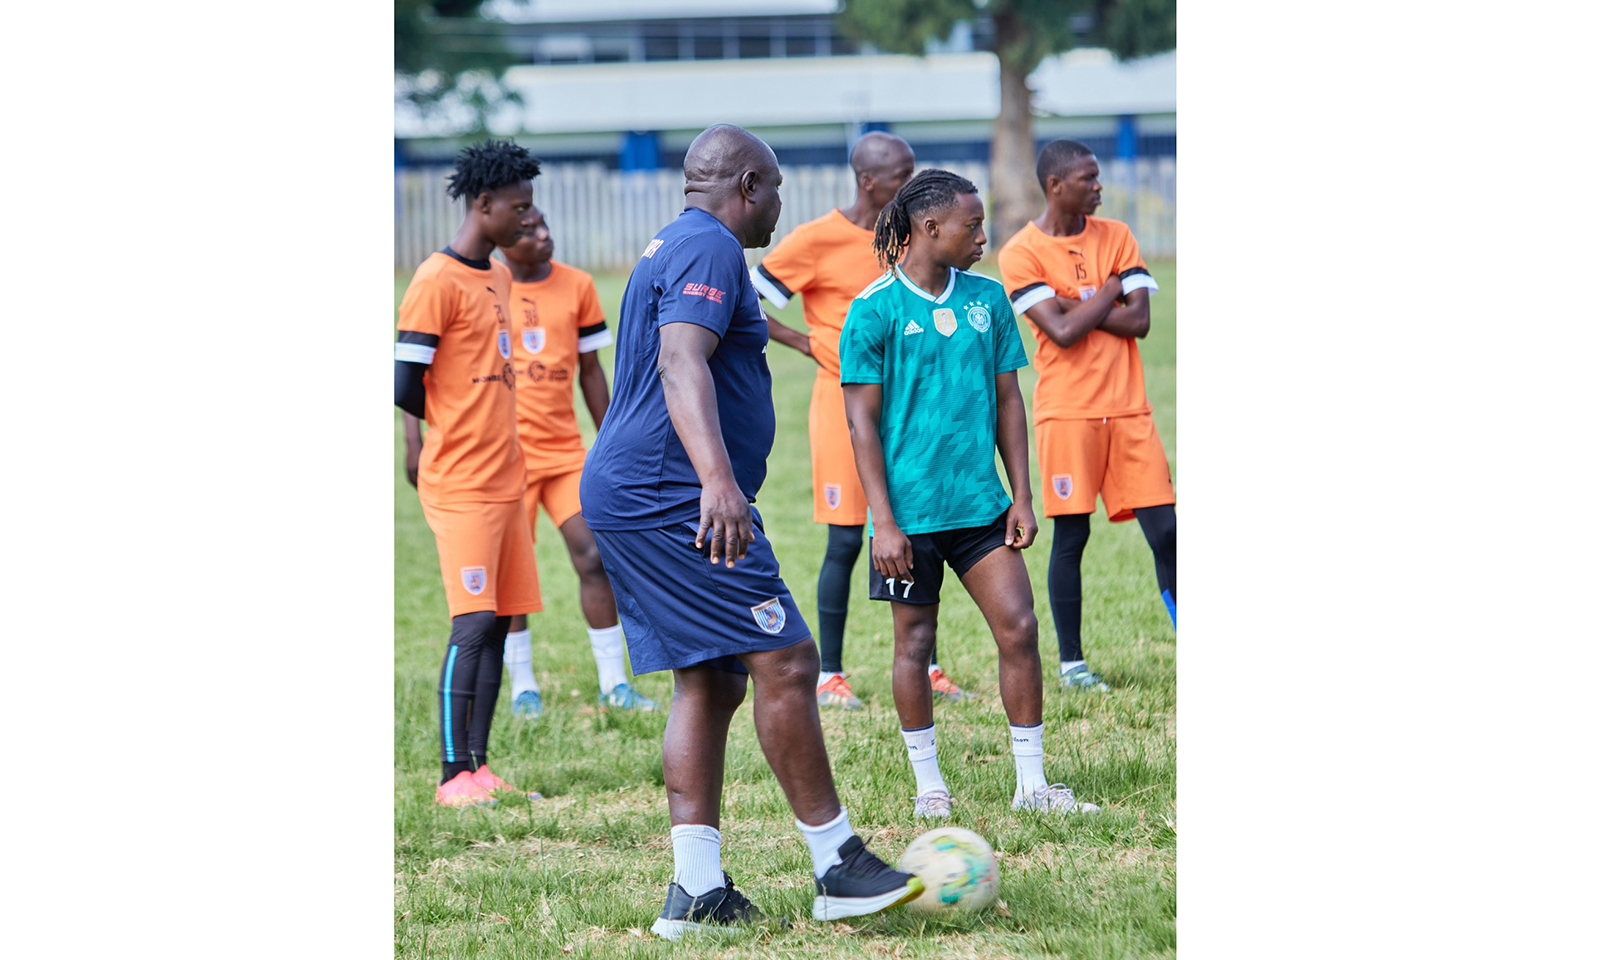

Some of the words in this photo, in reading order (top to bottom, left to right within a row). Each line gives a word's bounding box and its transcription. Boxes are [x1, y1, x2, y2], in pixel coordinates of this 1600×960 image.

[1075, 262, 1087, 281] 15
[683, 282, 723, 300] SURGE
[904, 327, 924, 336] adidas
[885, 577, 915, 599] 17
